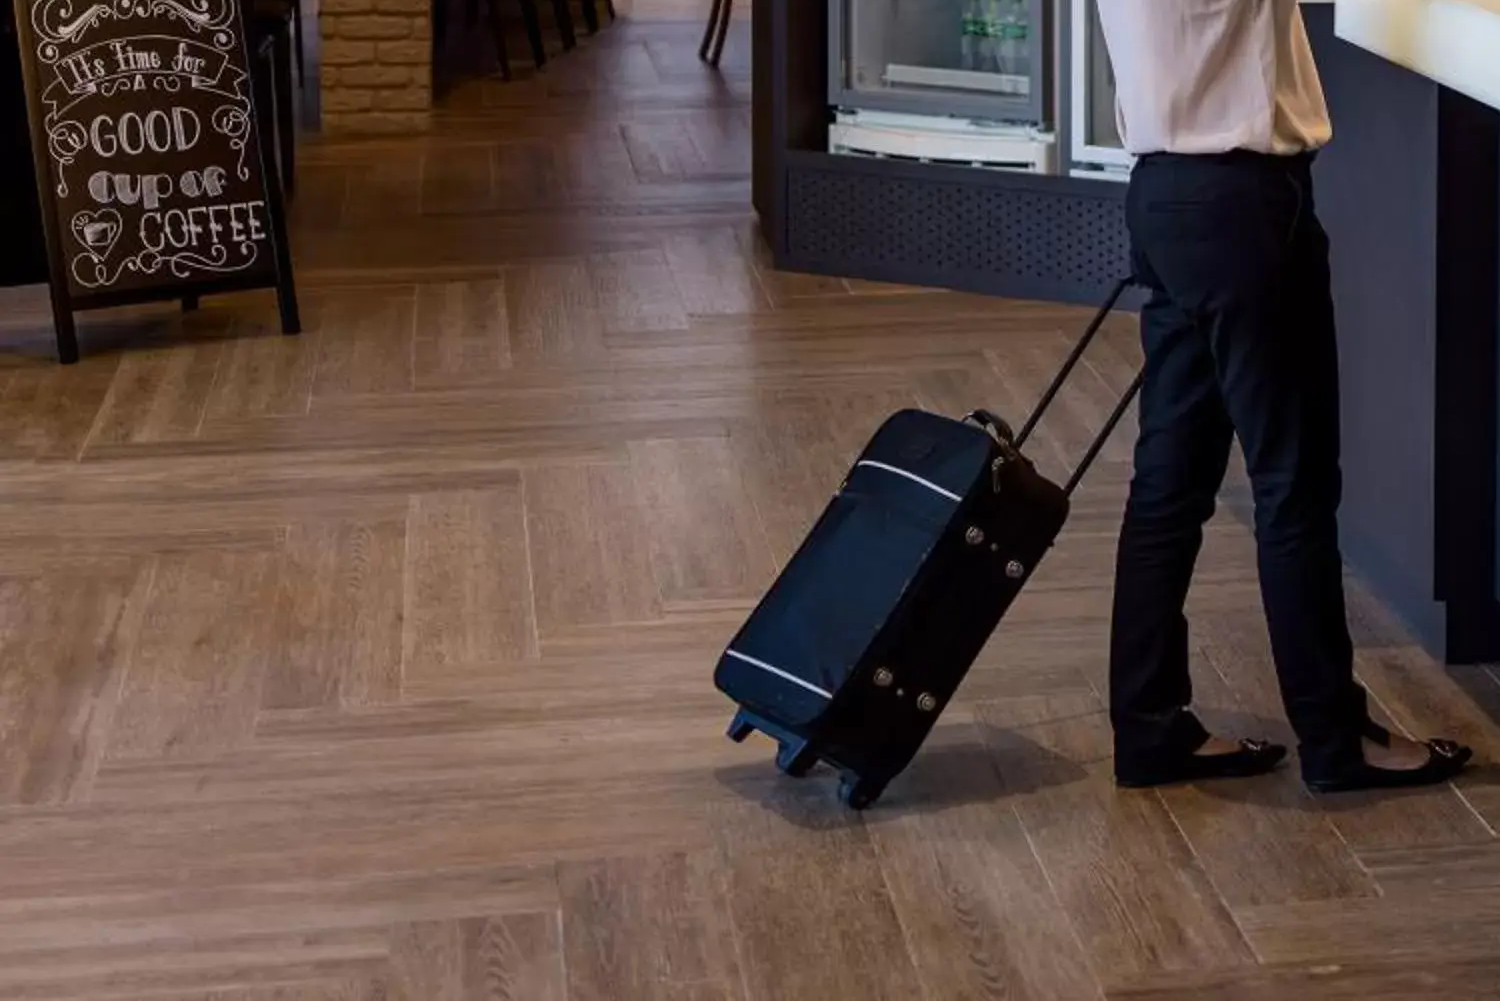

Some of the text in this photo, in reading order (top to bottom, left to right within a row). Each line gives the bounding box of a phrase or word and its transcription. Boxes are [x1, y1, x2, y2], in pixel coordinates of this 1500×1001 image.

[172, 42, 206, 73] for
[91, 107, 201, 157] GOOD
[140, 201, 267, 251] COFFEE
